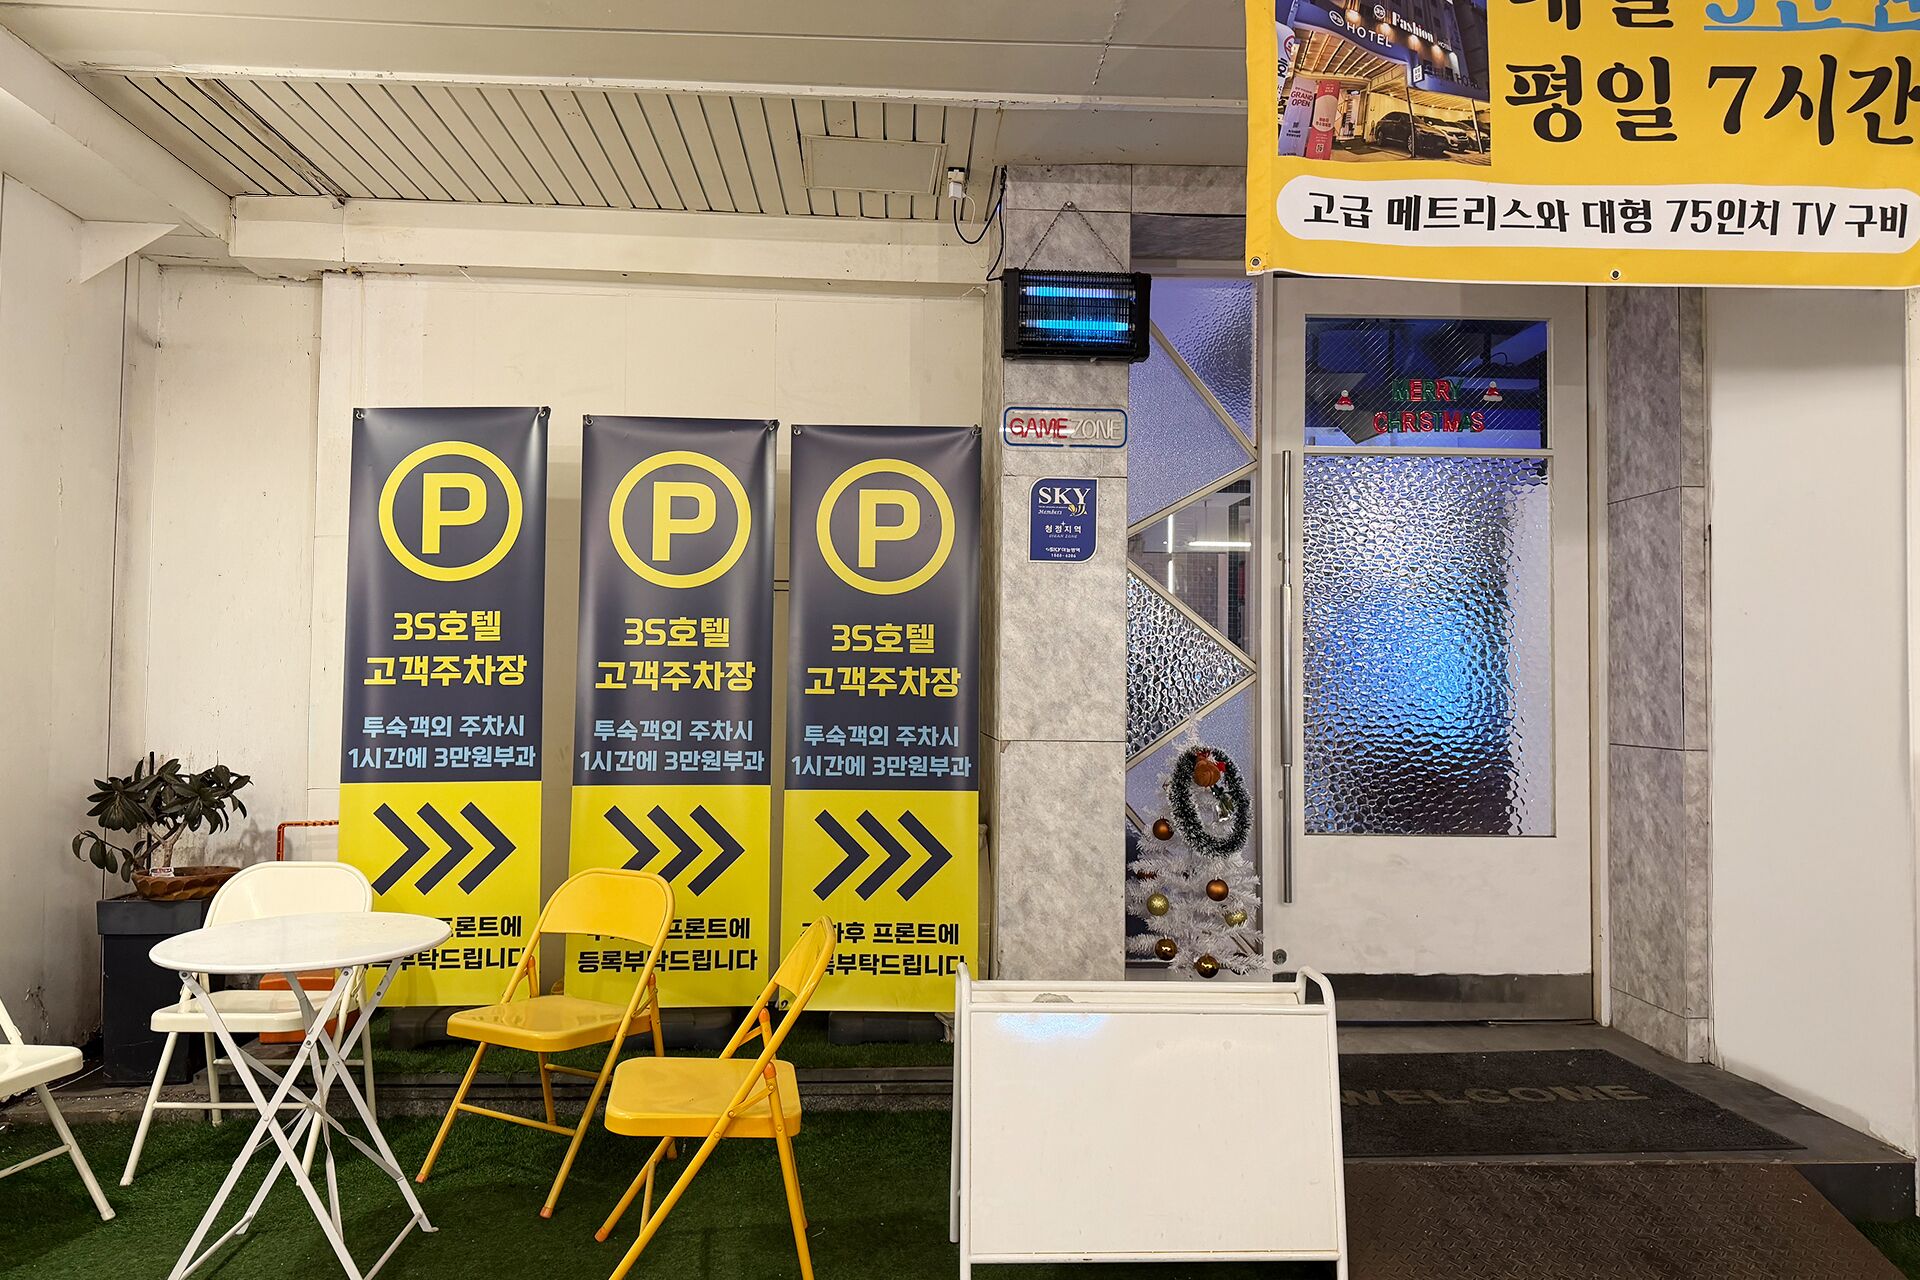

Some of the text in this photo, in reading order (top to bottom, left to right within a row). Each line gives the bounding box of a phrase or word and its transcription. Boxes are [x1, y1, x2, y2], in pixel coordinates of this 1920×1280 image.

[1346, 22, 1392, 48] HOTEL
[1391, 11, 1434, 43] Fashion
[1291, 90, 1313, 101] GRAND
[1291, 98, 1311, 107] OPEN
[1505, 54, 1920, 146] 평일 7시간
[1304, 192, 1908, 239] 고급 메트리스와 대형 75인치 TV 구비
[1392, 379, 1461, 401] MERRY
[1009, 417, 1122, 440] GAME ZONE
[1038, 486, 1091, 505] SKY
[392, 610, 502, 642] 3S호텔
[623, 616, 731, 648] 3S호텔
[831, 623, 935, 654] 3S호텔
[363, 654, 528, 687] 고객주차장
[595, 661, 756, 692] 고객주차장
[804, 667, 961, 697] 고객주차장
[362, 715, 526, 738] 투숙객외 주차시
[593, 720, 753, 741] 투숙객외 주차시
[803, 725, 959, 747] 투숙객외 주차시
[348, 746, 536, 769] 1시간에 3만원부과
[580, 750, 765, 772] 1시간에 3만원부과
[791, 755, 971, 777] 1시간에 3만원부과
[872, 923, 959, 945] 프론트에
